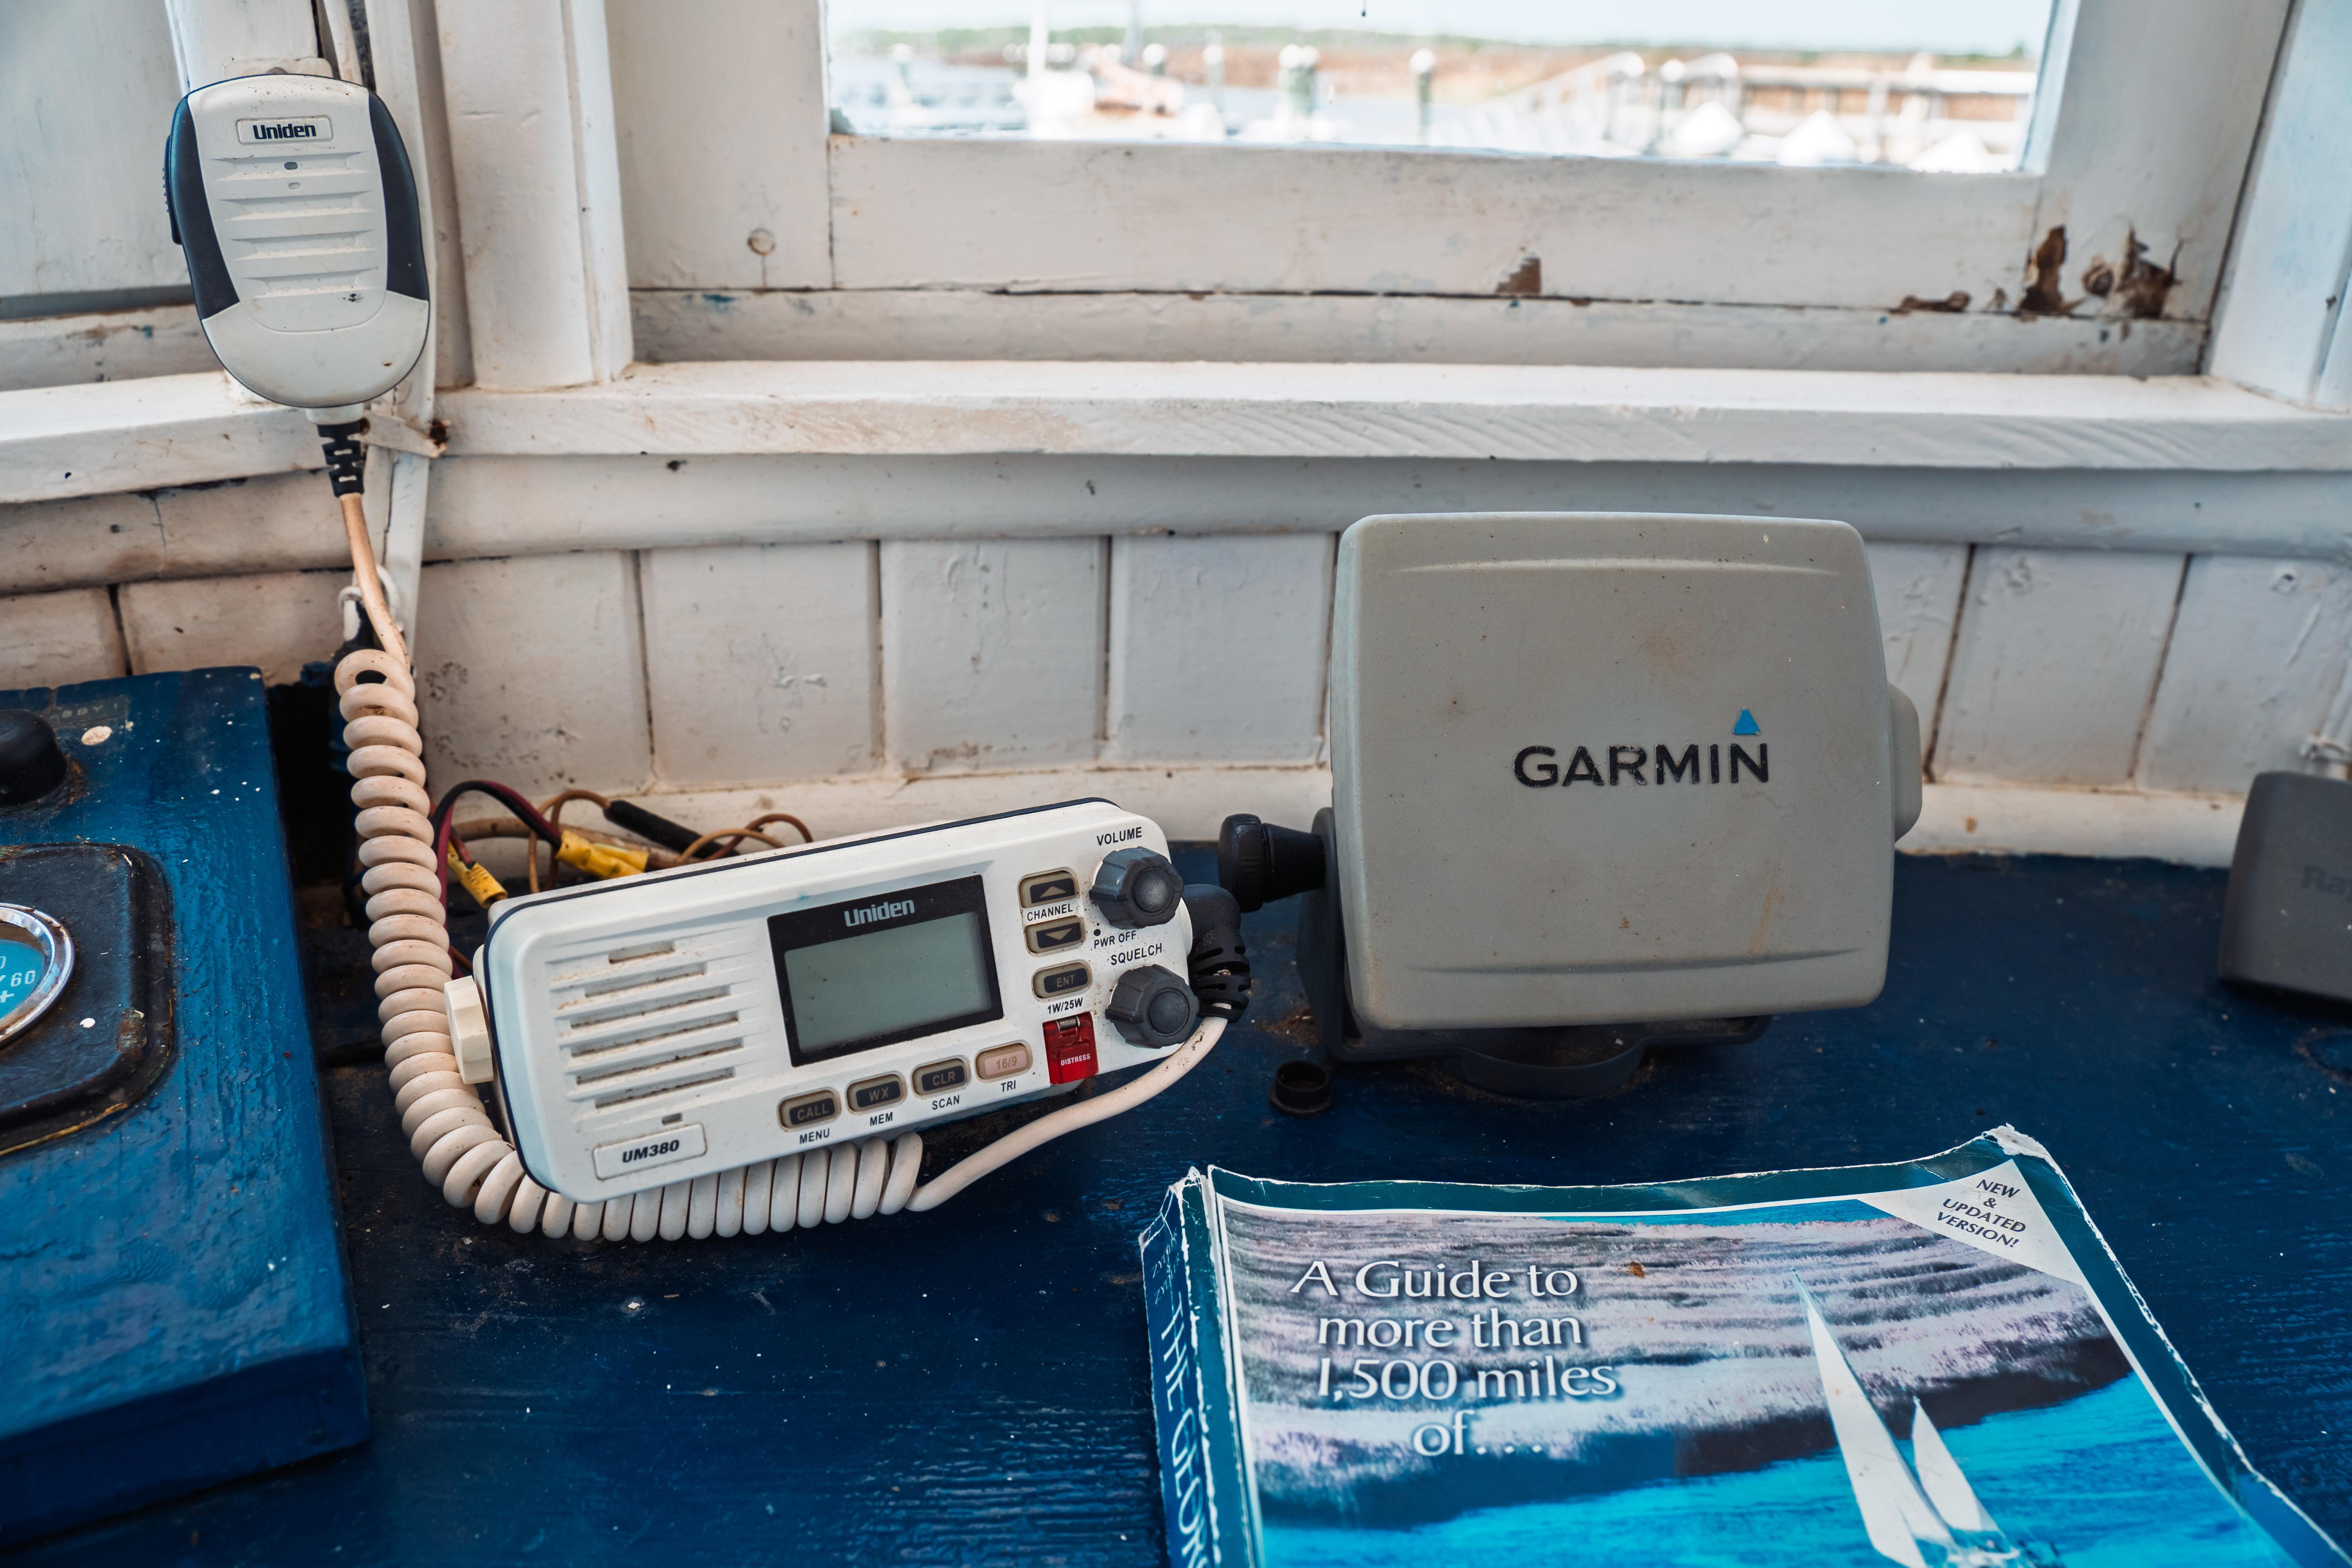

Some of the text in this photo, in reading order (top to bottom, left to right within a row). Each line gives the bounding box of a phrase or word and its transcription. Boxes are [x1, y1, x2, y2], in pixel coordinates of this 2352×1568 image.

[253, 123, 316, 139] Uniden
[1513, 743, 1769, 787] GARMIN
[1096, 827, 1142, 846] VOLUME
[844, 900, 915, 927] Uniden
[1027, 903, 1073, 922] CHANNEL
[1094, 931, 1137, 949] PWR OFF
[1111, 943, 1163, 965] SQUELCH
[11, 970, 36, 987] 60
[1056, 974, 1075, 988] ENT
[1047, 998, 1083, 1014] 1W/25W
[995, 1056, 1017, 1071] 16/9
[1060, 1053, 1091, 1066] DISTRESS
[933, 1071, 956, 1087] CLR
[1001, 1080, 1016, 1093] TRI
[869, 1088, 890, 1102] WX
[932, 1095, 960, 1111] SCAN
[797, 1105, 829, 1122] CALL
[869, 1112, 893, 1127] MEM
[799, 1128, 830, 1144] MENU
[622, 1140, 679, 1163] UM380
[1976, 1179, 2020, 1198] NEW
[1983, 1197, 1997, 1209] &
[1943, 1198, 2026, 1232] UPDATED
[1937, 1211, 2019, 1247] VERSION!
[1290, 1260, 1578, 1298] A Guide to
[1318, 1308, 1581, 1348] more than
[1161, 1291, 1190, 1412] THE
[1318, 1356, 1617, 1402] 1,500 miles
